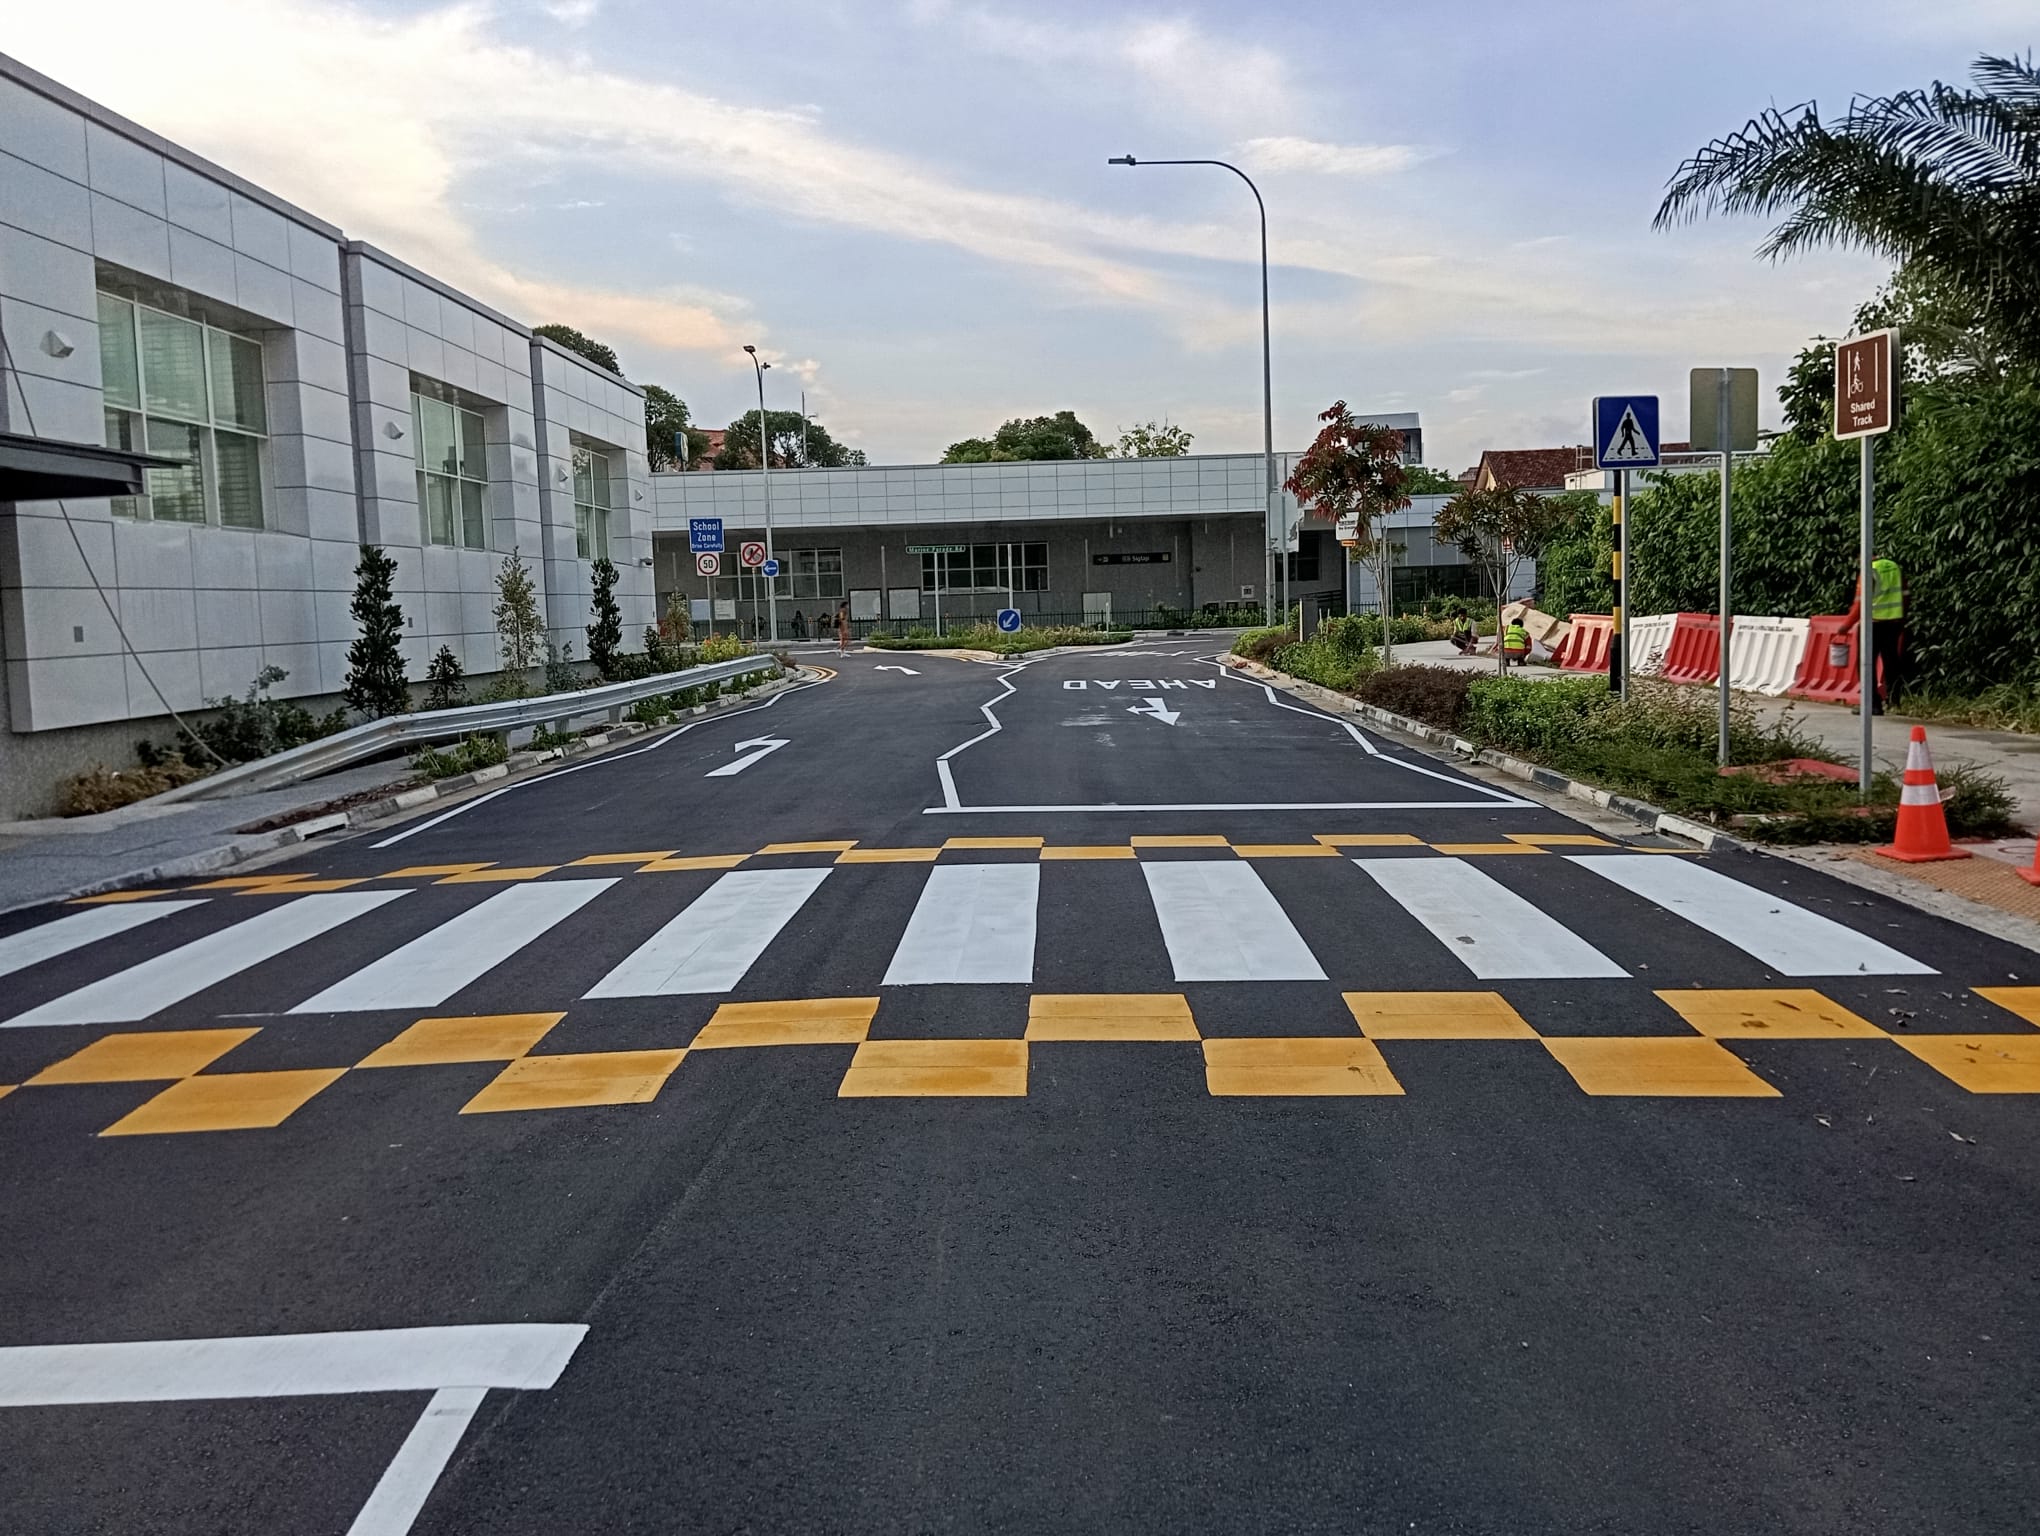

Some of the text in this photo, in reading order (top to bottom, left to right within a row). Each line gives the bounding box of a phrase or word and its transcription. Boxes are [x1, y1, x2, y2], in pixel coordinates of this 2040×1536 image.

[1850, 398, 1876, 414] Shared
[1852, 413, 1873, 427] Track
[692, 521, 720, 531] School
[697, 532, 717, 542] Zone
[703, 559, 714, 569] 50
[1063, 679, 1216, 690] AHEAD
